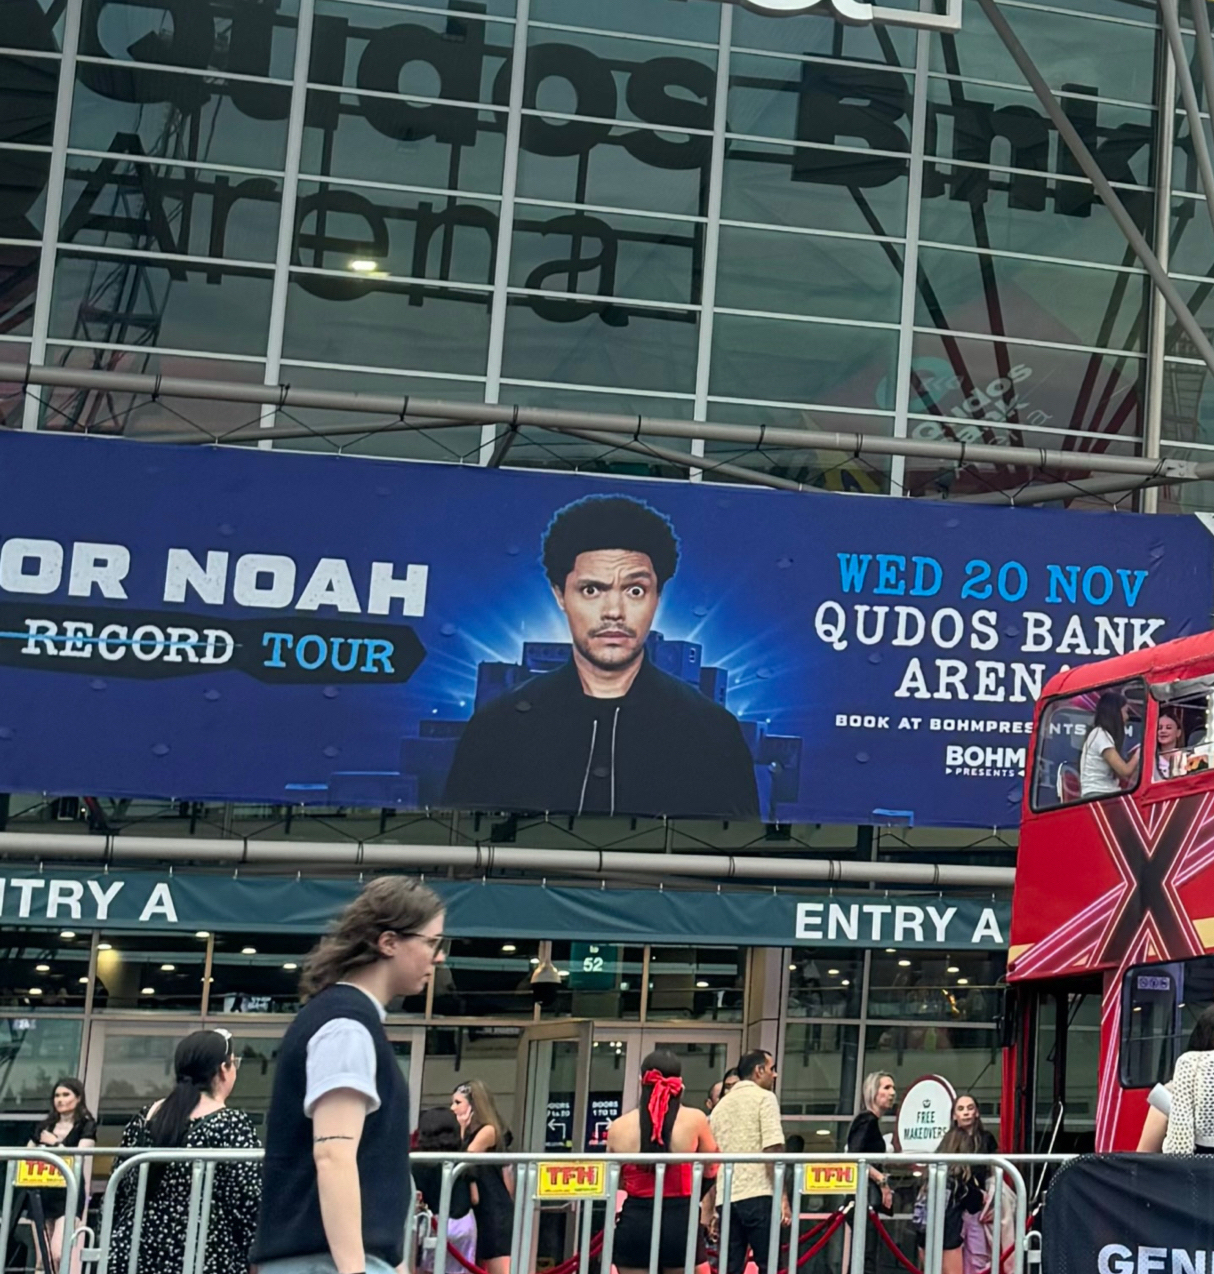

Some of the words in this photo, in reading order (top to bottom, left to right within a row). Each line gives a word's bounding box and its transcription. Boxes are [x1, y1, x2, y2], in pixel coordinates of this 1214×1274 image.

[163, 548, 429, 617] NOAH
[837, 553, 943, 597] WED
[960, 559, 1028, 602] 20
[1045, 564, 1149, 607] NOV
[815, 600, 998, 651] QUDOS
[1021, 612, 1166, 654] BANK
[22, 619, 235, 664] RECORD
[262, 631, 396, 673] TOUR
[895, 658, 1070, 702] AREN
[835, 714, 890, 729] BOOK
[898, 717, 922, 730] AT
[946, 745, 1026, 768] BOHM
[955, 768, 1015, 777] PRESENTS
[139, 882, 179, 922] A
[795, 902, 957, 942] ENTRY
[972, 908, 1004, 944] A
[583, 956, 604, 972] 52
[592, 1101, 619, 1109] DOORS
[917, 1111, 936, 1124] FREE
[903, 1127, 948, 1140] MAKEOVERS
[546, 1166, 599, 1185] TFH
[811, 1166, 854, 1182] TFH
